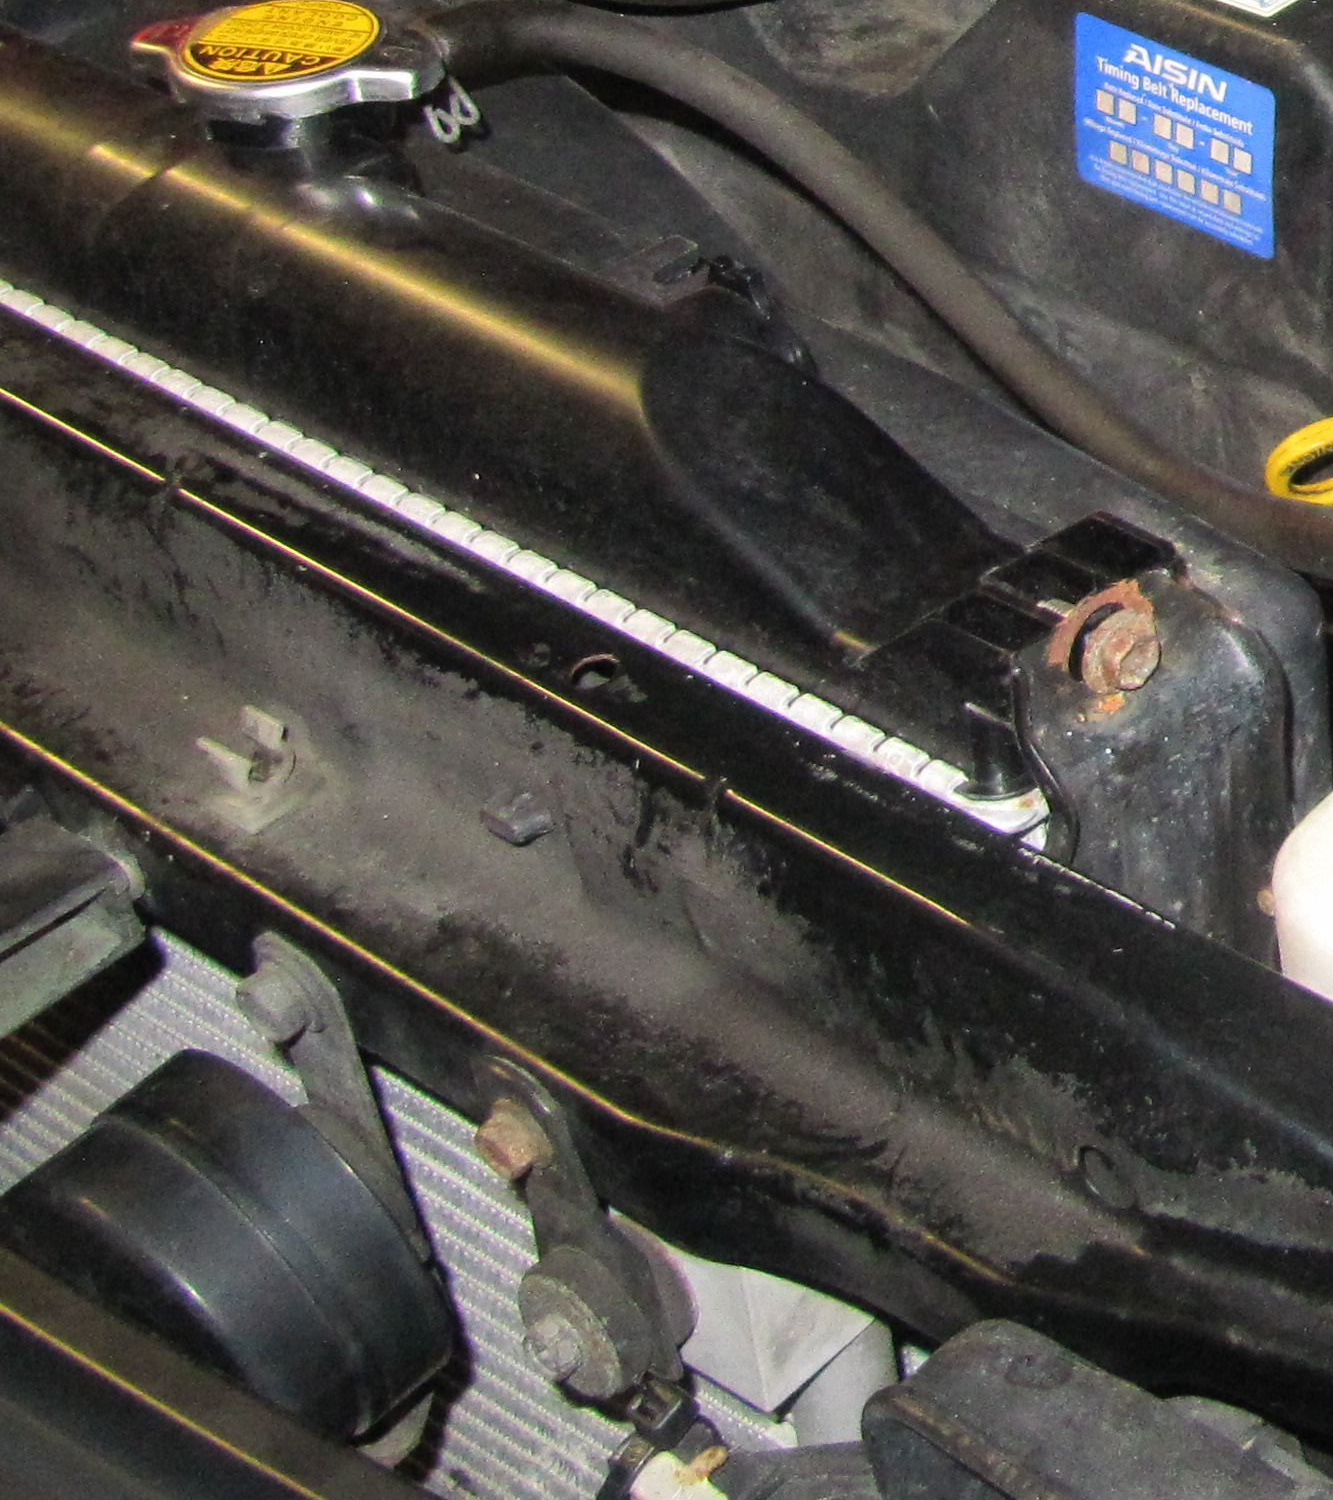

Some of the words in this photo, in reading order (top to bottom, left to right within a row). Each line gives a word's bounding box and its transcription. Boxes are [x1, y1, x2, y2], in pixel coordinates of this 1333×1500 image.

[199, 45, 320, 65] CAUTION
[1124, 43, 1228, 103] AISIN
[1096, 55, 1138, 91] Timing
[1143, 75, 1166, 98] Belt
[1171, 85, 1252, 138] Replacement
